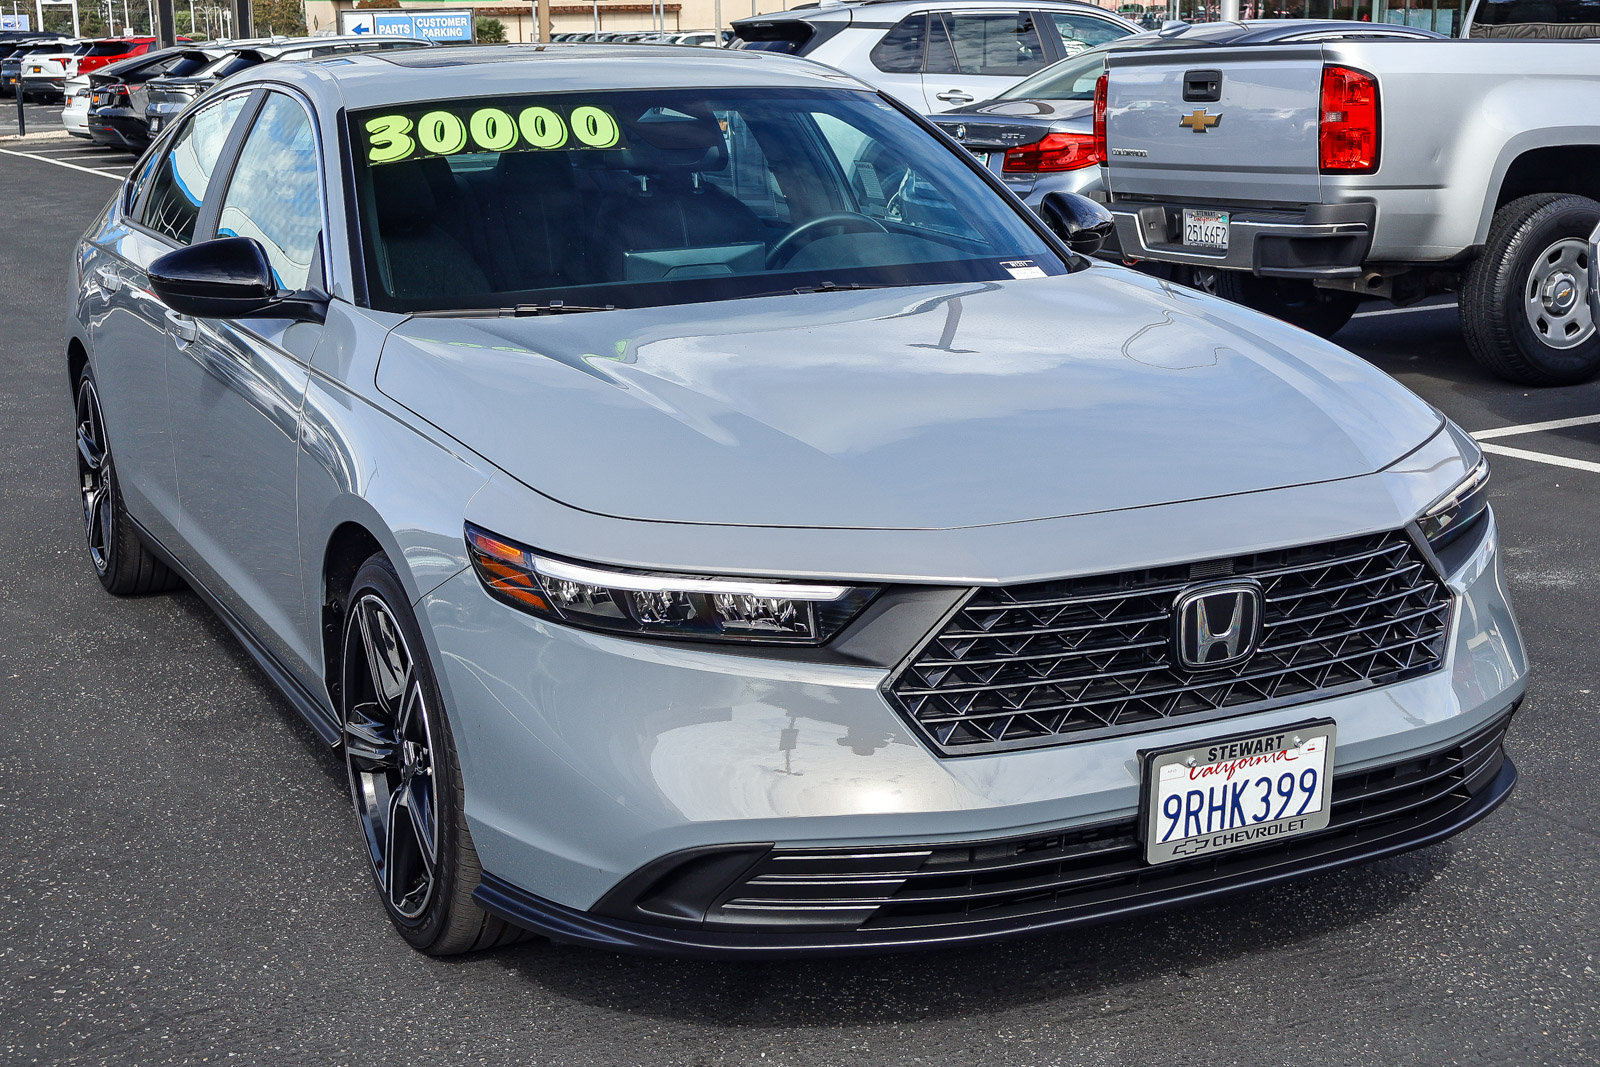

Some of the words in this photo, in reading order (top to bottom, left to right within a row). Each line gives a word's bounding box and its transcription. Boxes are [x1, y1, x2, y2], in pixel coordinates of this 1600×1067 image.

[380, 24, 411, 35] PARTS
[416, 17, 468, 28] CUSTOMER
[422, 28, 463, 37] PARKING
[365, 106, 620, 163] 30000
[1187, 224, 1227, 244] 25166F2
[1207, 735, 1285, 762] STEWART
[1189, 749, 1299, 781] California
[1161, 768, 1317, 842] 9RHK399
[1212, 818, 1308, 848] CHEVROLET
